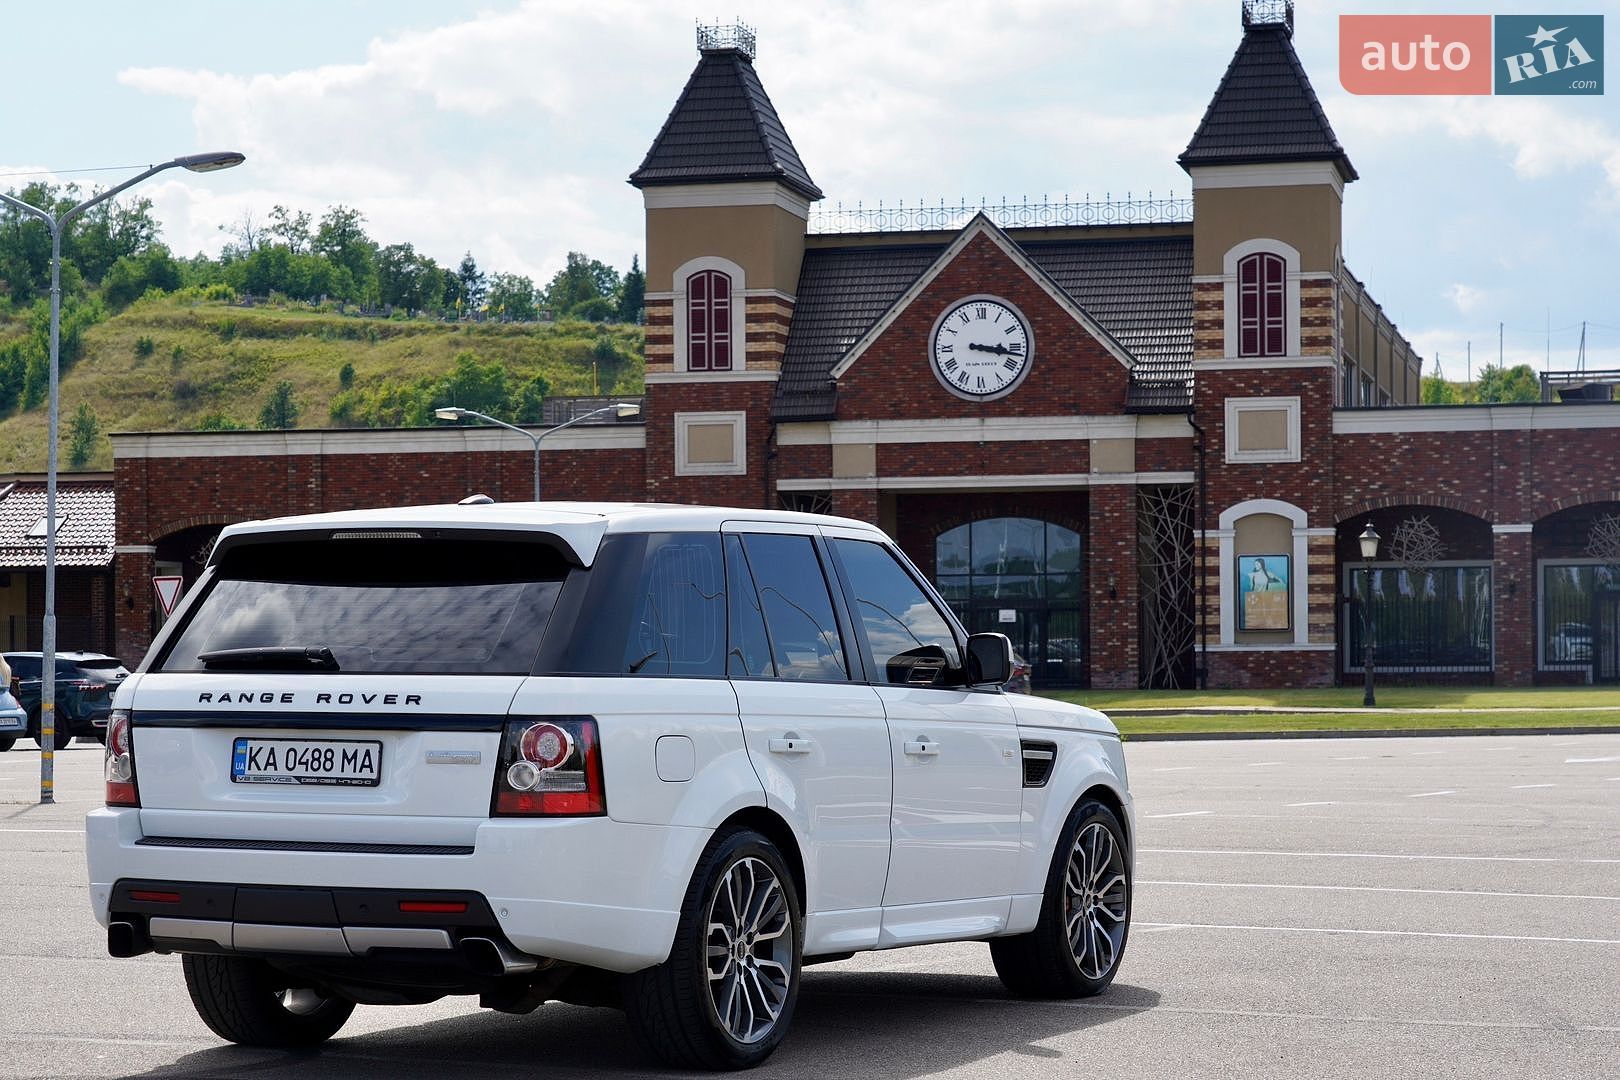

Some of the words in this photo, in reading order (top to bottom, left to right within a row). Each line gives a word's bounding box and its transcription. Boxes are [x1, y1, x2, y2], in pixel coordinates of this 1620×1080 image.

[198, 692, 295, 704] RANGE
[316, 693, 423, 706] ROVER
[247, 746, 278, 772] KA
[285, 747, 334, 772] 0488
[340, 748, 375, 774] MA
